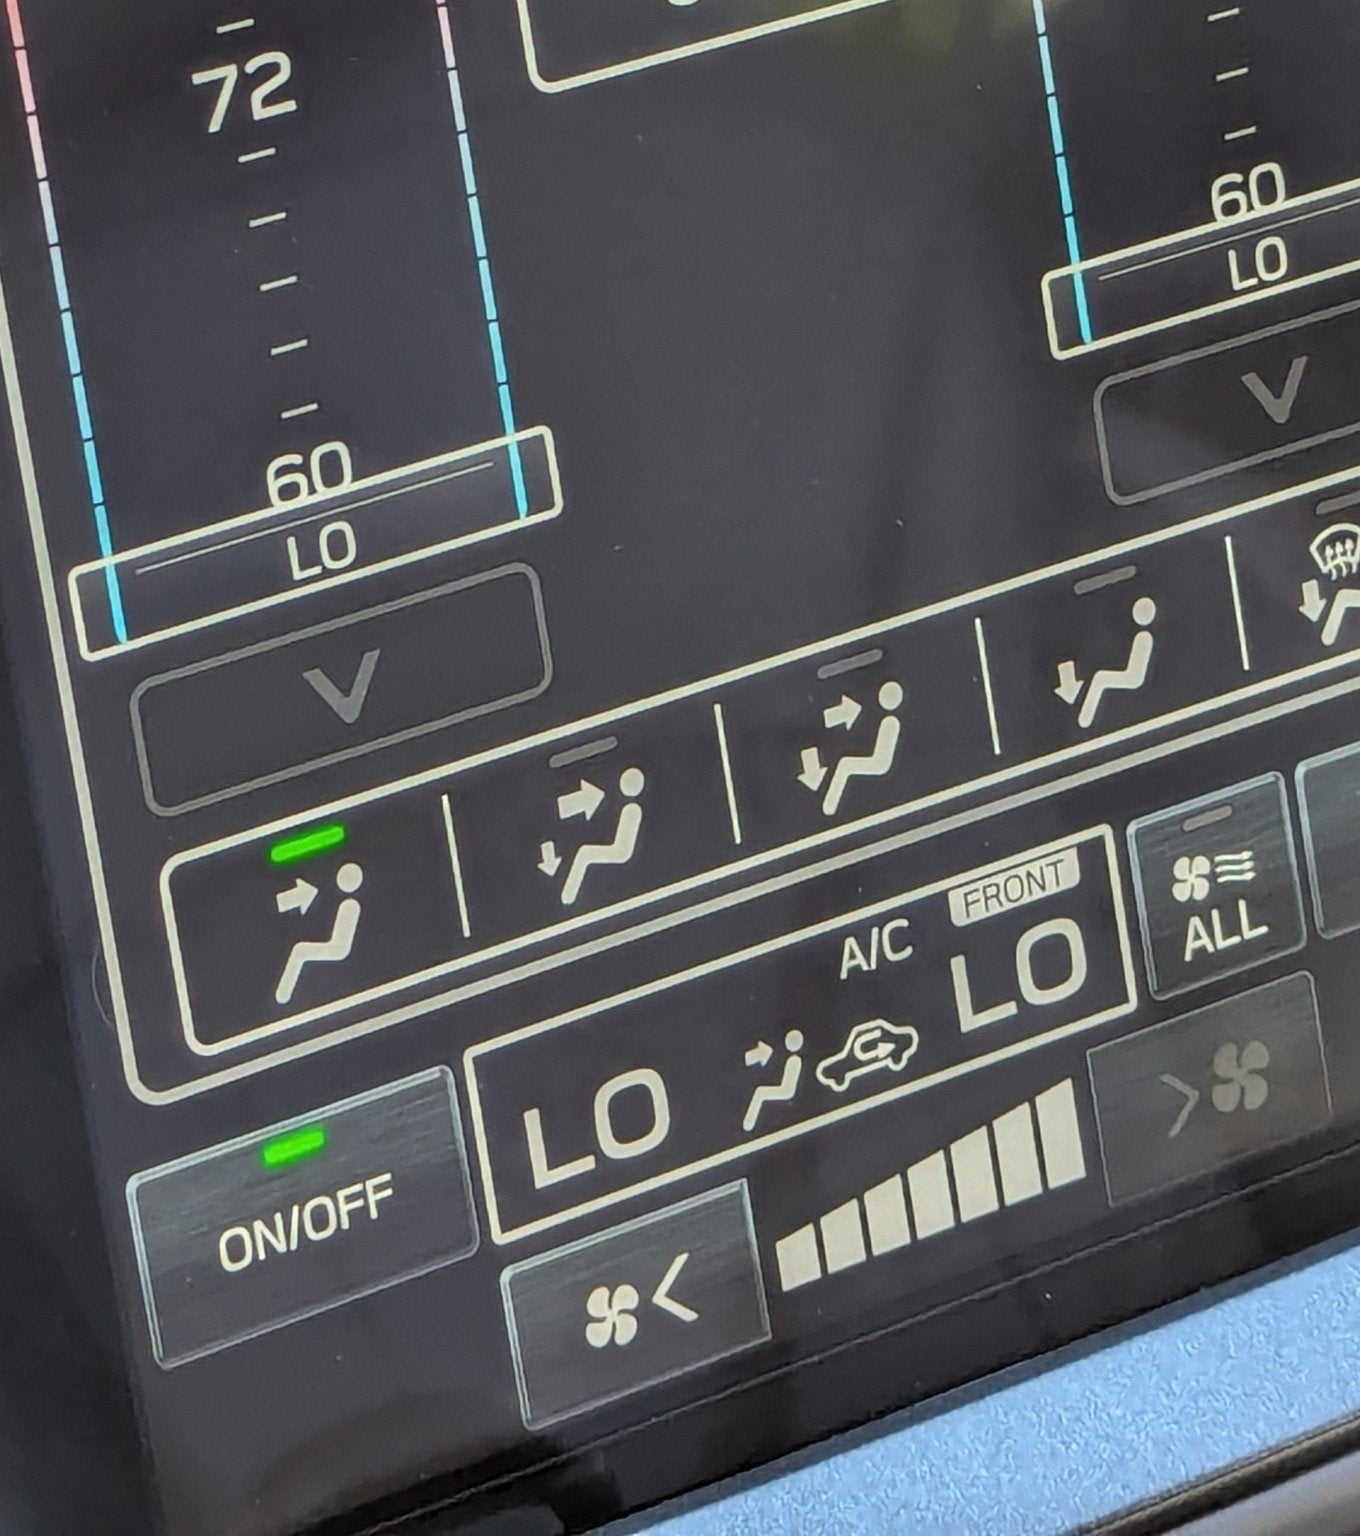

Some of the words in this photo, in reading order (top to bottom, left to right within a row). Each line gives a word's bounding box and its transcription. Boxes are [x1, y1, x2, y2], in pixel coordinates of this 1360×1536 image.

[191, 50, 297, 134] 72
[1209, 161, 1288, 224] 60
[1226, 237, 1289, 290] LO
[265, 441, 360, 510] 60
[285, 524, 360, 582] LO
[963, 861, 1066, 919] FRONT
[839, 919, 914, 980] A/C
[1183, 907, 1269, 963] ALL
[951, 917, 1088, 1034] LO
[524, 1067, 670, 1190] LO
[218, 1172, 396, 1272] ON/OFF
